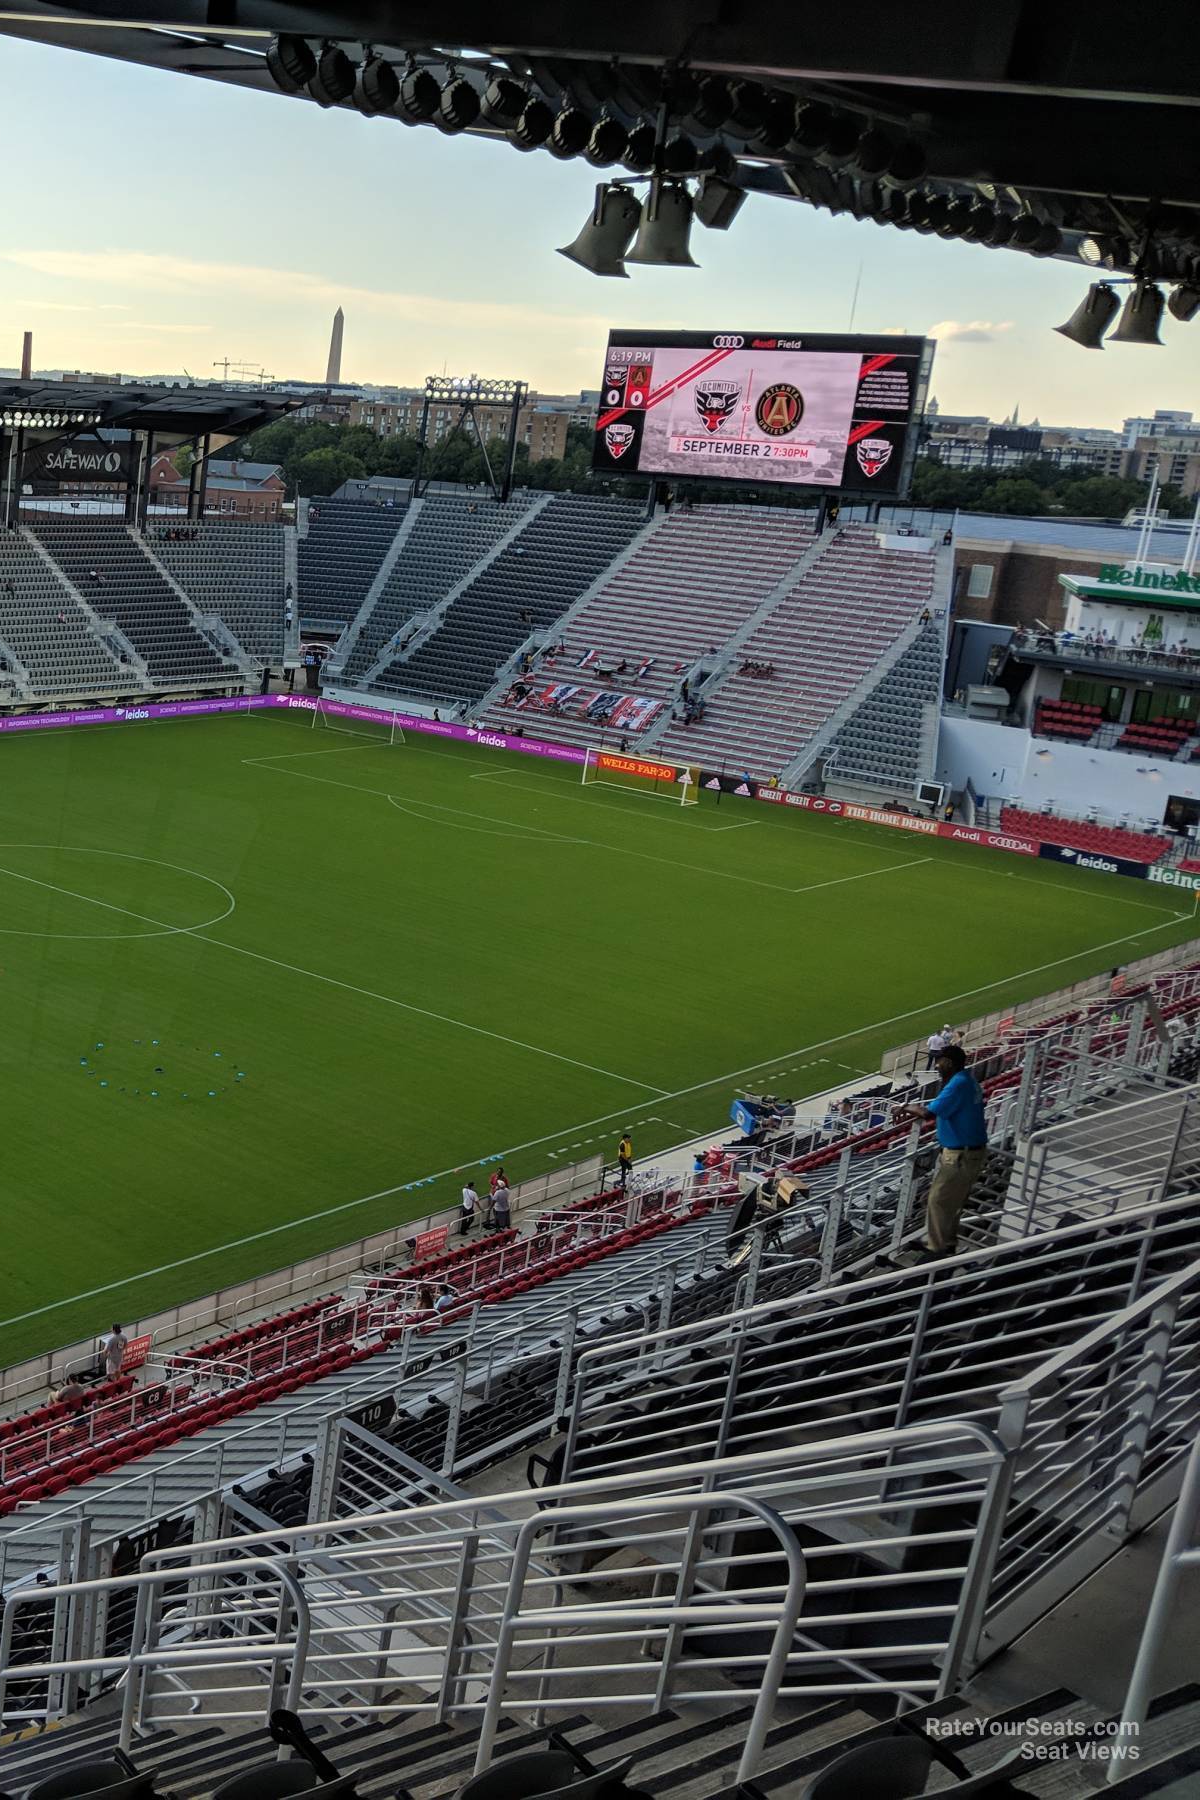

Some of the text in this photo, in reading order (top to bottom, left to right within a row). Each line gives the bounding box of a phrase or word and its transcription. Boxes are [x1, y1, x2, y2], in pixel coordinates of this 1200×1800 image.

[752, 339, 802, 349] Audi Field
[611, 351, 652, 362] 6:19 PM
[607, 389, 620, 405] 0
[630, 390, 643, 406] 0
[765, 385, 799, 399] ATLANTA
[759, 420, 784, 435] UNITED
[682, 440, 760, 456] SEPTEMBER
[763, 445, 772, 457] 2
[773, 447, 808, 458] 7:30PM
[45, 453, 105, 469] SAFEWAY
[288, 697, 317, 710] leidos
[125, 708, 149, 720] leidos
[477, 732, 506, 748] leidos
[602, 757, 636, 771] WELLS
[847, 805, 868, 818] THE
[869, 809, 899, 825] HOME
[901, 815, 937, 832] DEPOT
[952, 829, 980, 841] Audi
[1076, 853, 1118, 873] leidos
[449, 1345, 460, 1357] 109
[148, 1391, 160, 1405] C8
[361, 1405, 382, 1425] 110
[133, 1532, 158, 1557] 111
